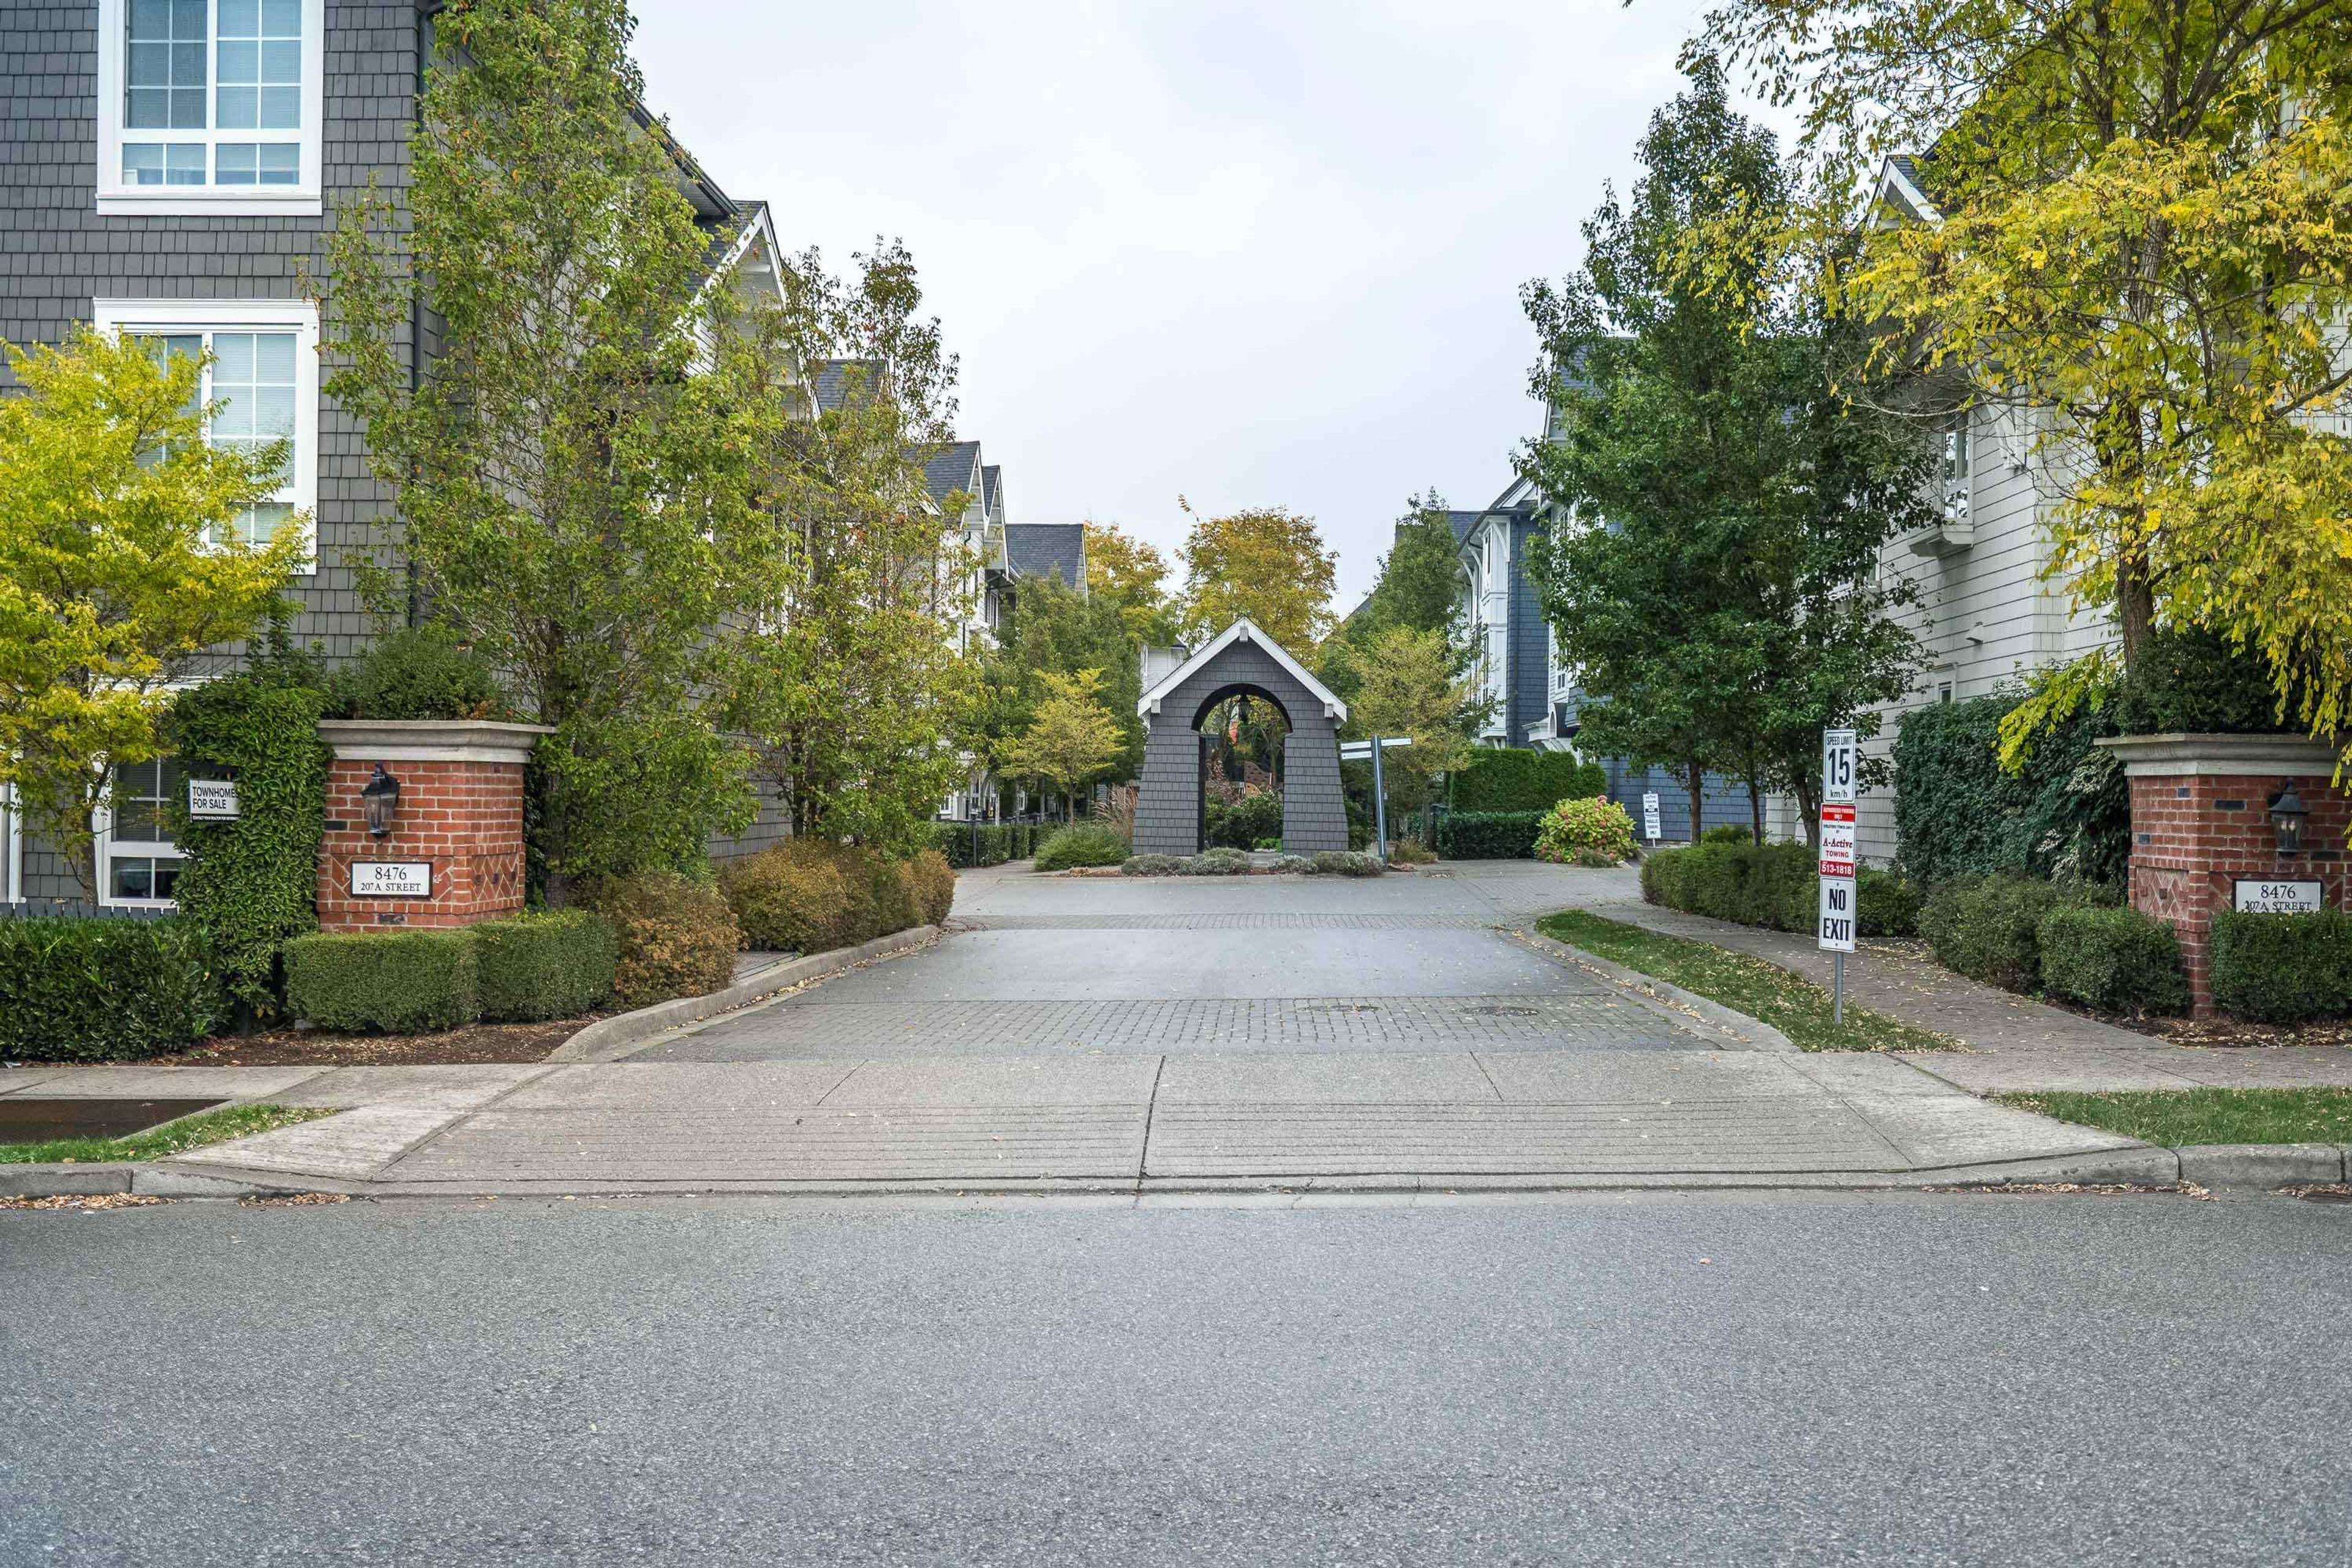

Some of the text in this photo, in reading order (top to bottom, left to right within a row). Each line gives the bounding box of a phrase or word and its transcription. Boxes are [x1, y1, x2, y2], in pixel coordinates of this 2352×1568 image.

[1827, 736, 1852, 745] SPEED LIMIT
[1828, 748, 1850, 785] 15
[1830, 790, 1847, 798] km/h
[193, 798, 226, 809] FOR SALE
[1823, 837, 1853, 848] A-Active
[375, 867, 407, 880] 8476
[1822, 864, 1852, 875] 513-1818
[385, 883, 421, 892] STREET
[2261, 884, 2296, 899] 8476
[1829, 888, 1846, 911] NO
[2272, 902, 2312, 910] STREET
[1823, 917, 1851, 941] EXIT
